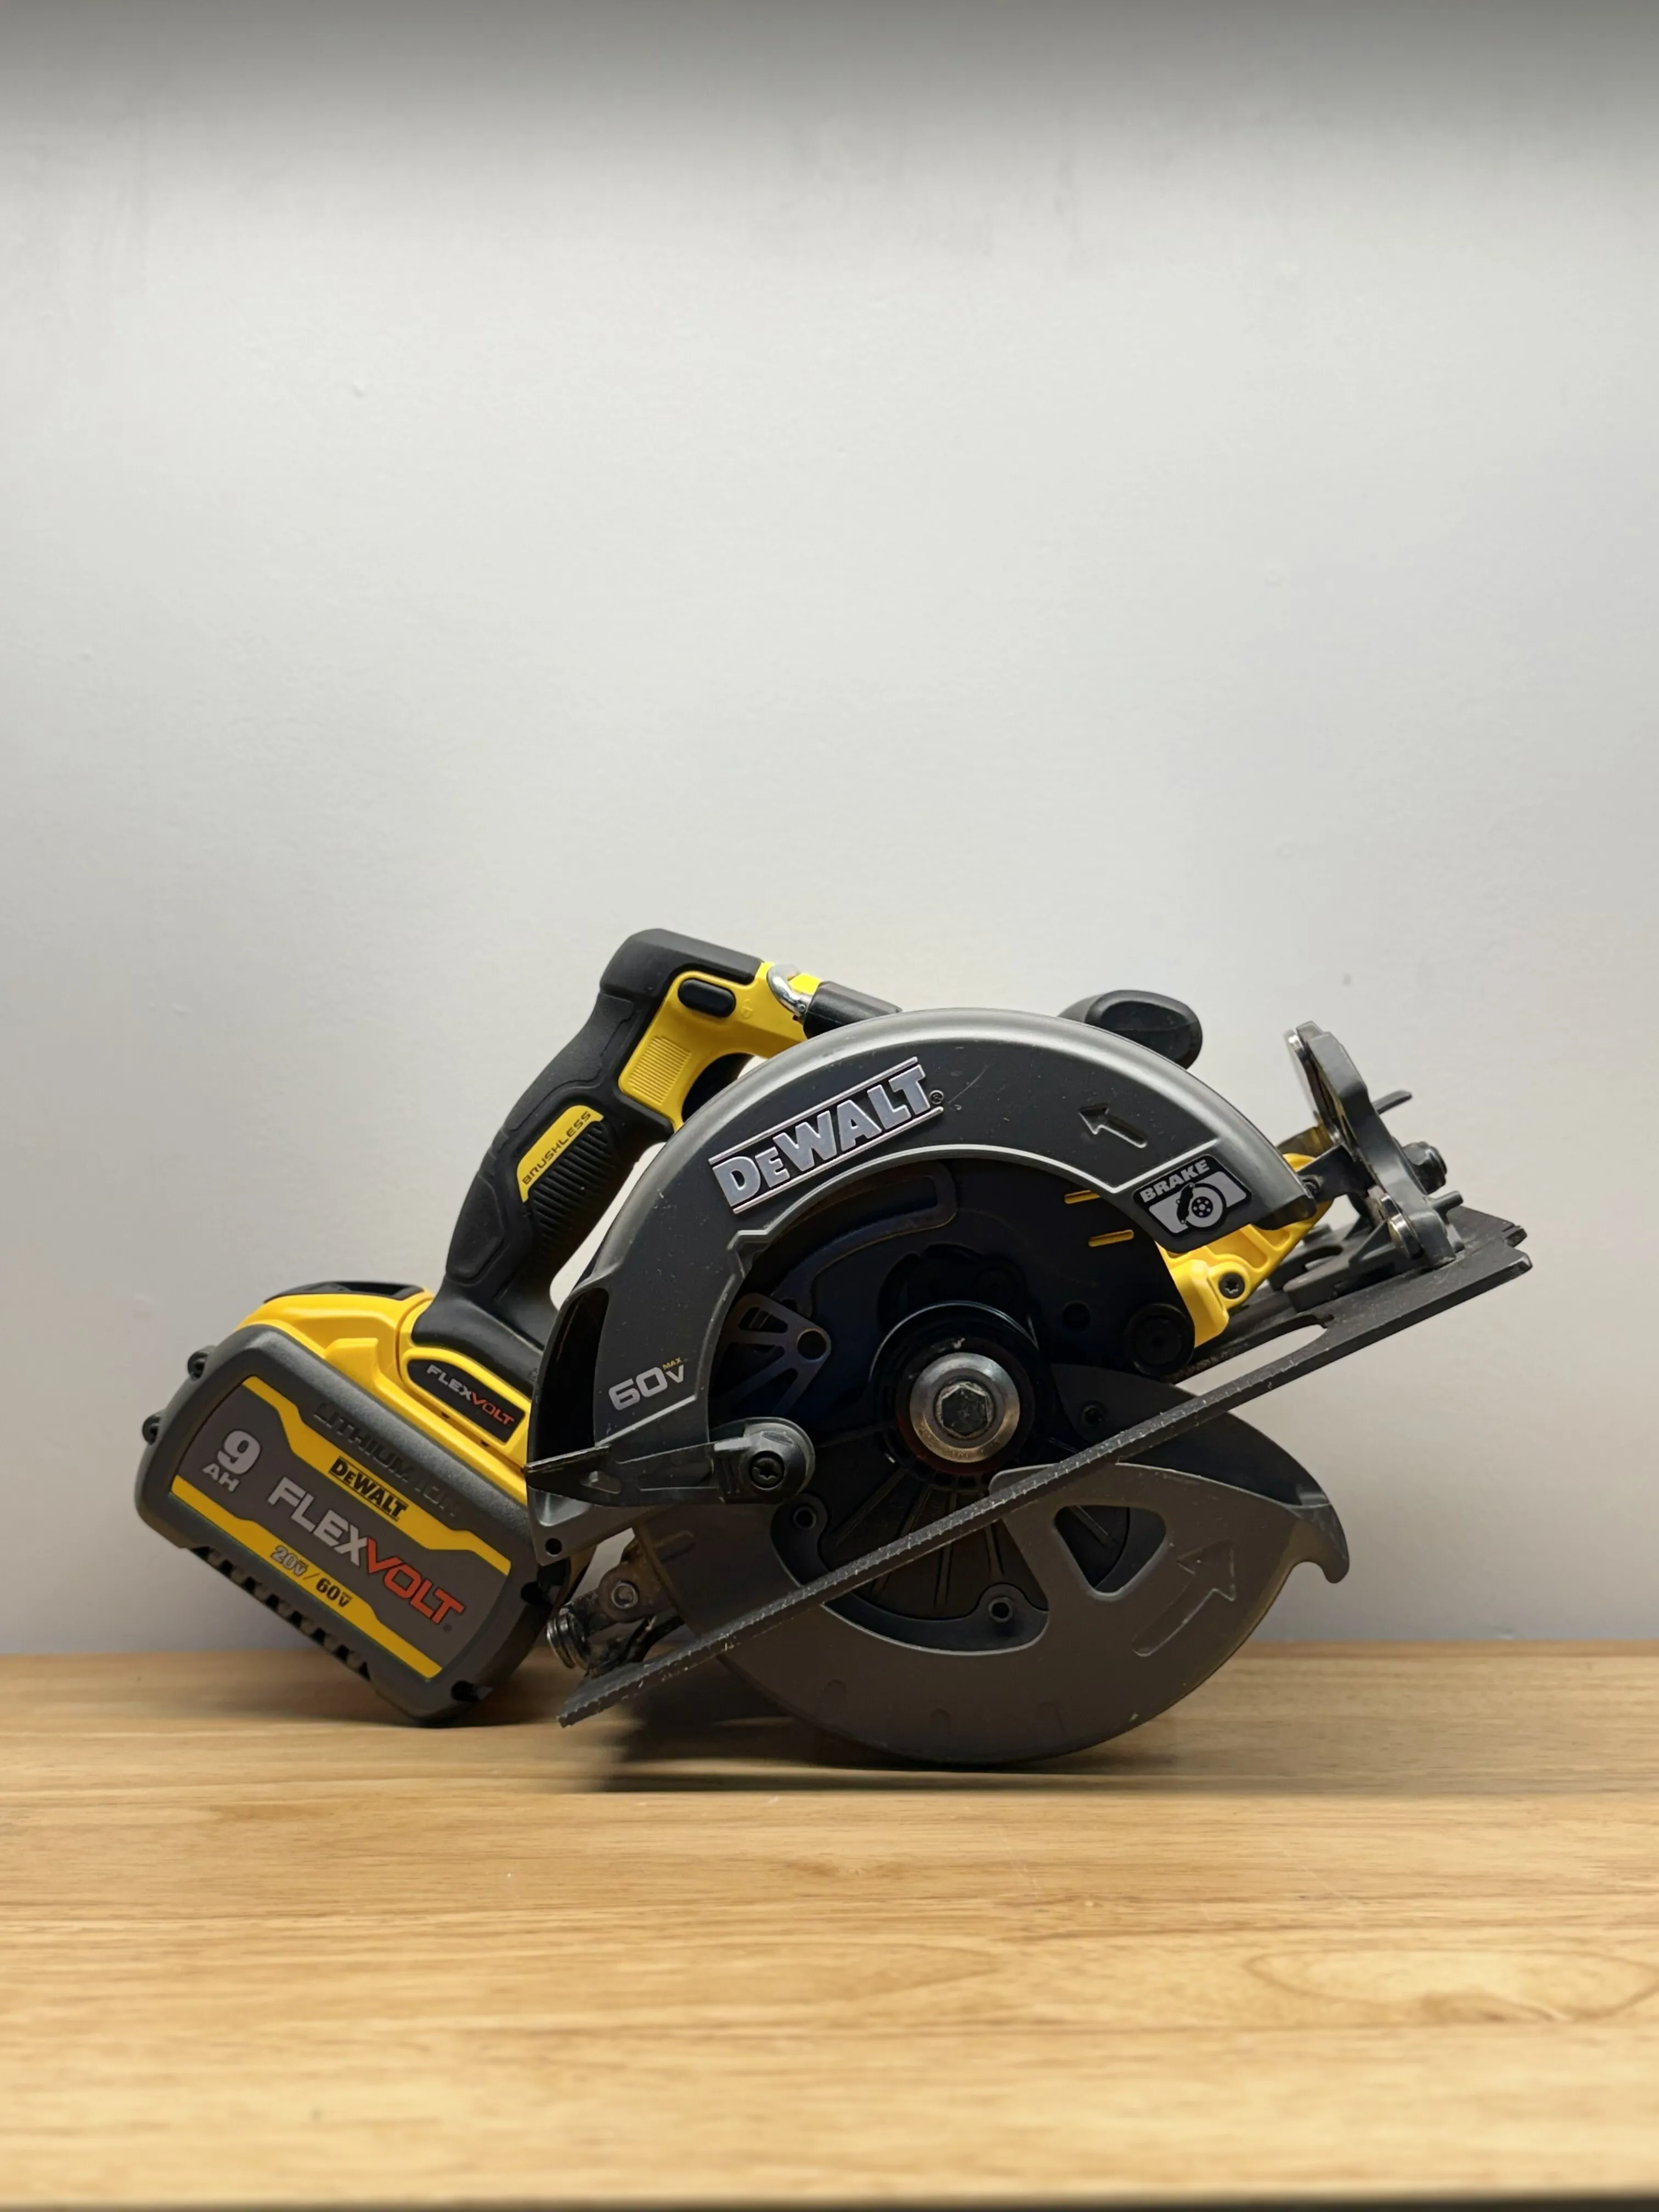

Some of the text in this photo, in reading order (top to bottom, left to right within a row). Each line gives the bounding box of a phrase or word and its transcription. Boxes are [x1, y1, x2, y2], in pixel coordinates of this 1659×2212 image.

[522, 1111, 591, 1185] BRUSHLESS
[1139, 1159, 1210, 1203] BRAKE
[662, 1357, 682, 1370] MAX
[426, 1364, 515, 1425] FLEXVOLT
[217, 1430, 261, 1475] 9
[312, 1402, 415, 1483] LITHIUM
[201, 1463, 240, 1492] AH
[266, 1476, 465, 1623] FLEXVOLT
